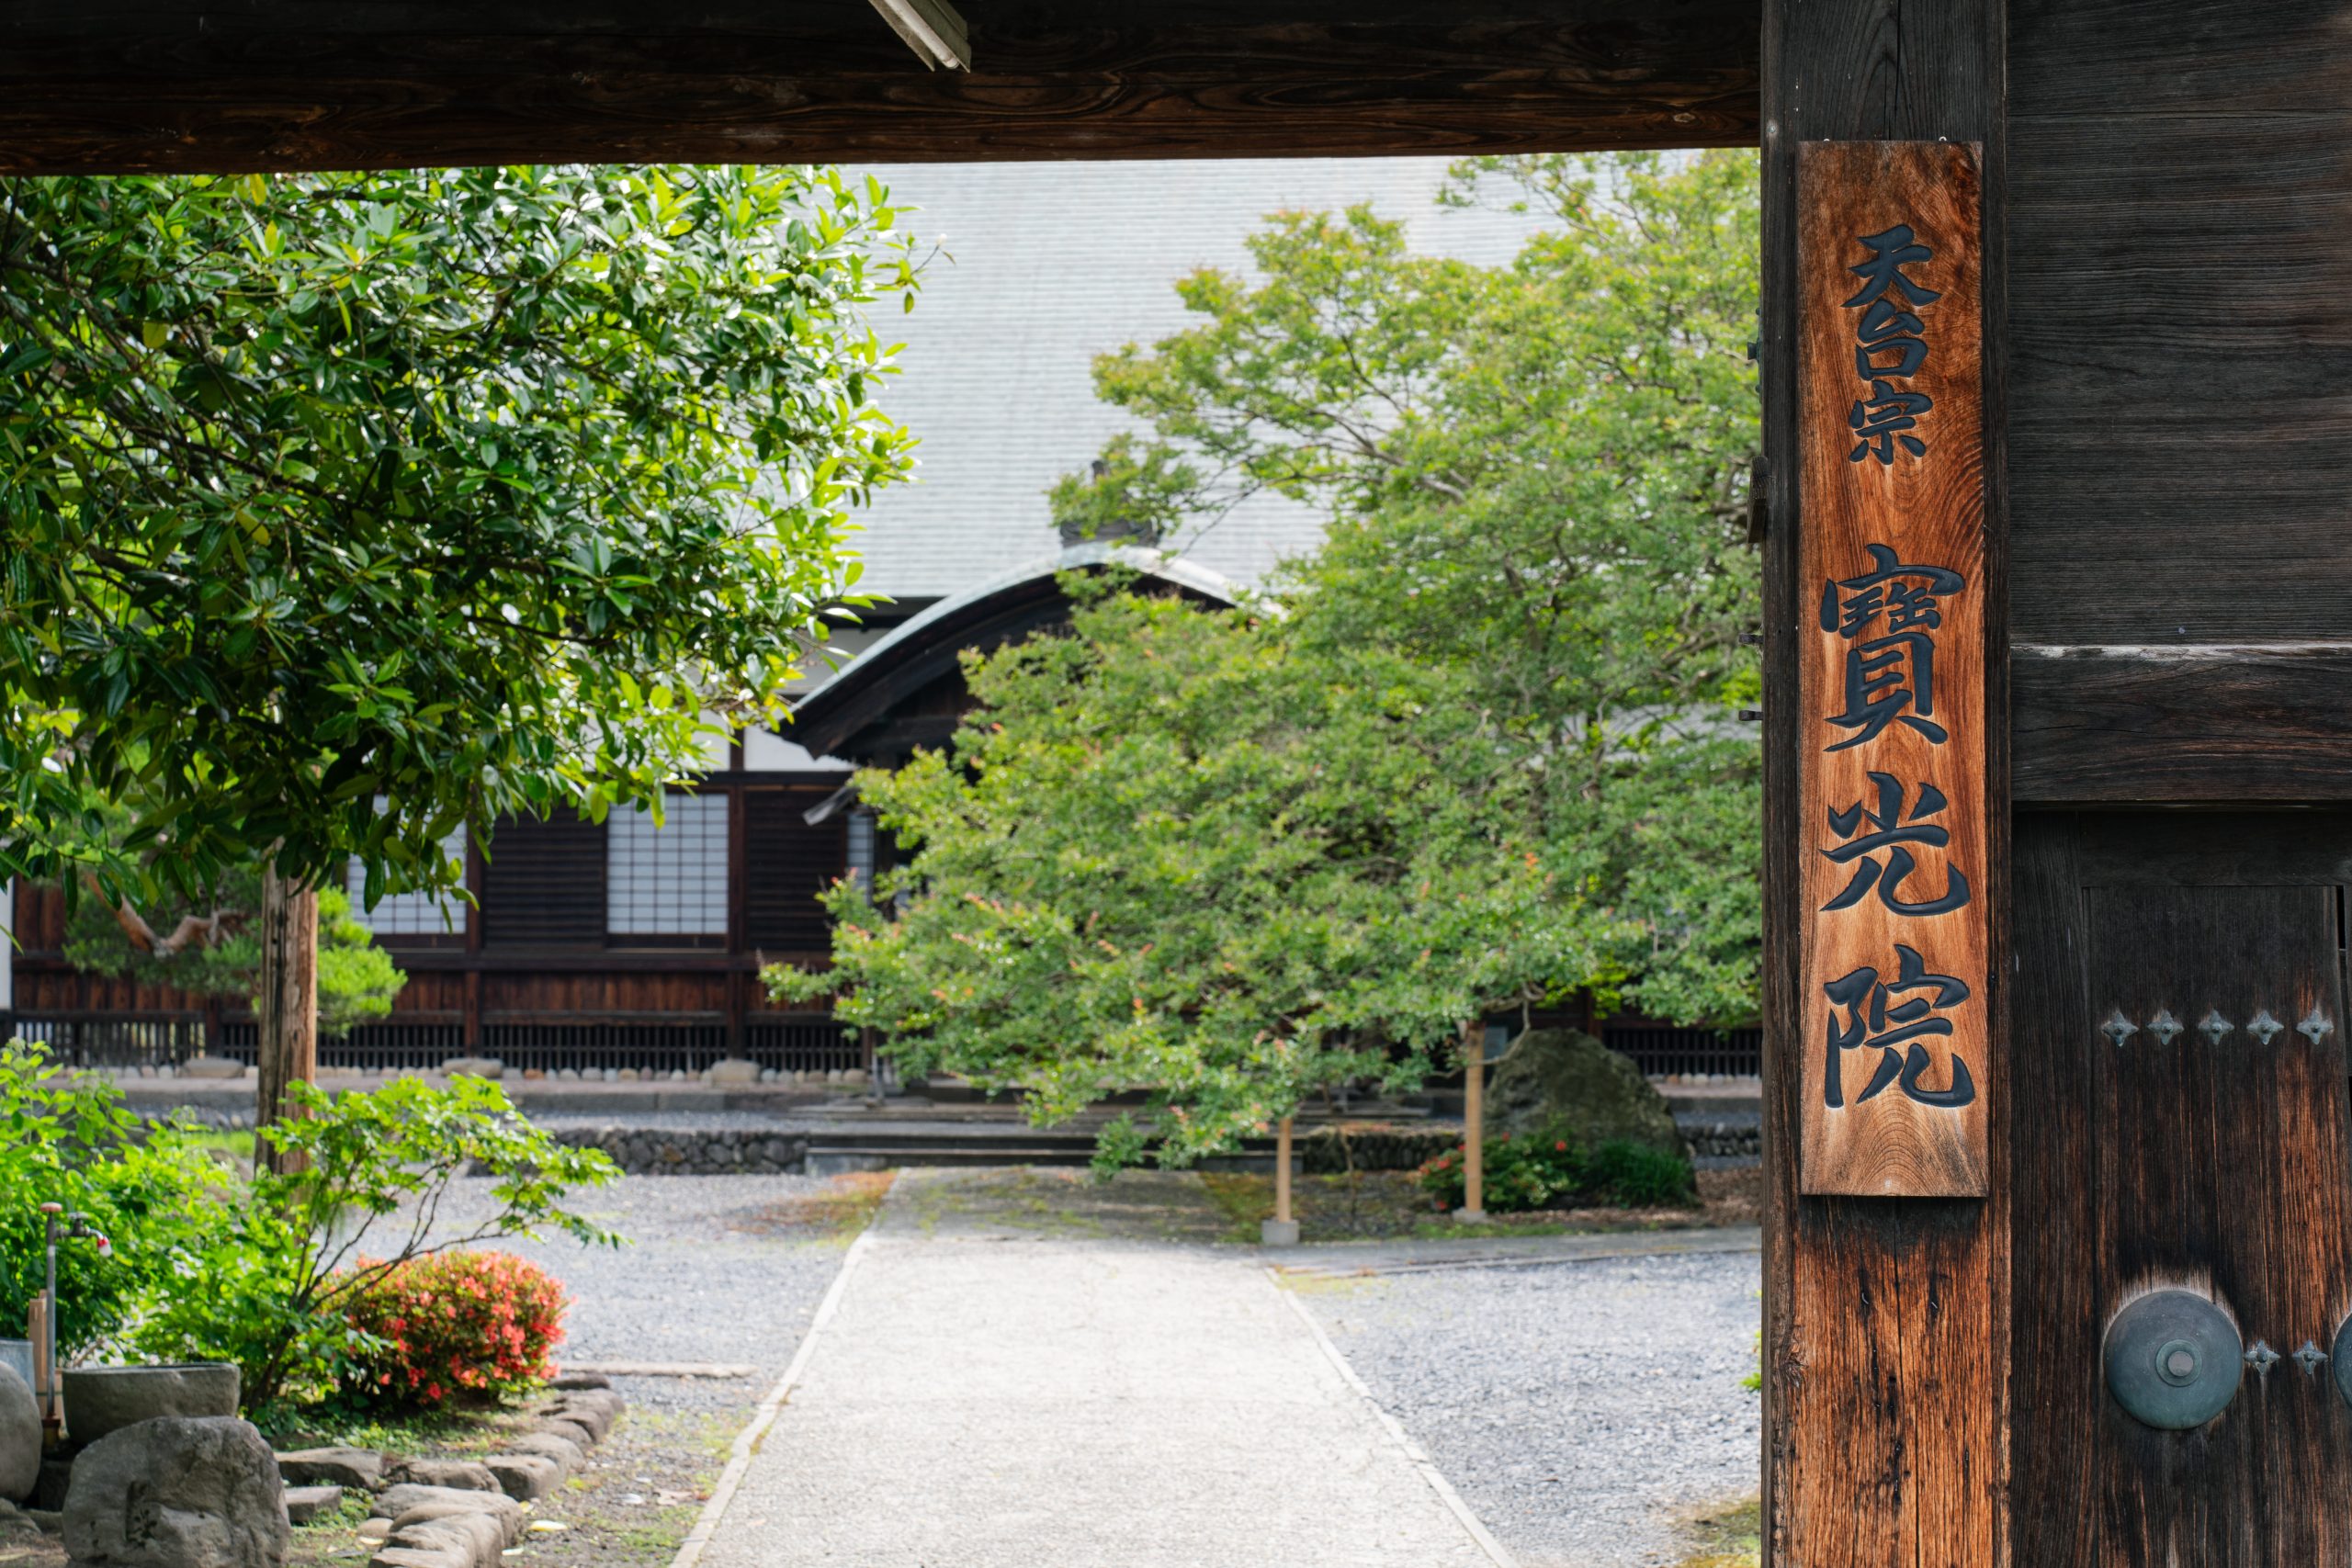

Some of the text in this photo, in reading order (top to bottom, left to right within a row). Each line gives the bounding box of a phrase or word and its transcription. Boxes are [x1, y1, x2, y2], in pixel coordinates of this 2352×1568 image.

[1819, 224, 1976, 1109] 天台宗 寶光院
